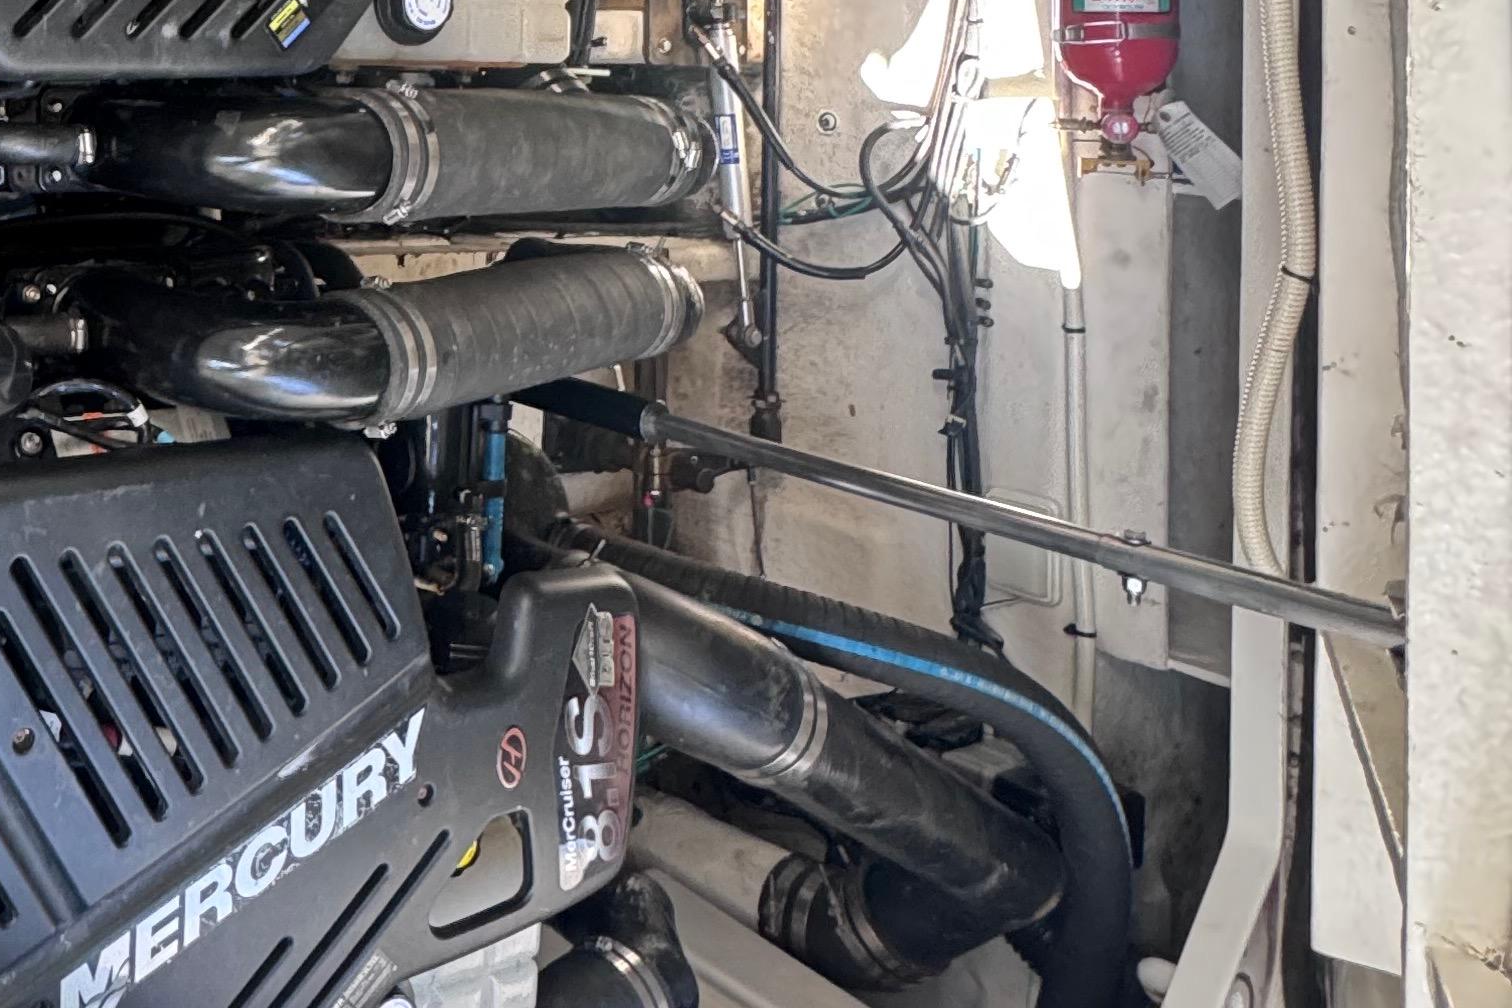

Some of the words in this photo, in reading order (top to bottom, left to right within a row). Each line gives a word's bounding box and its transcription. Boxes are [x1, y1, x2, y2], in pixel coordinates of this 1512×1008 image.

[564, 695, 622, 862] 8.1S
[617, 623, 634, 777] HORIZON
[60, 707, 426, 1008] MERCURY
[558, 755, 578, 873] MerCruiser
